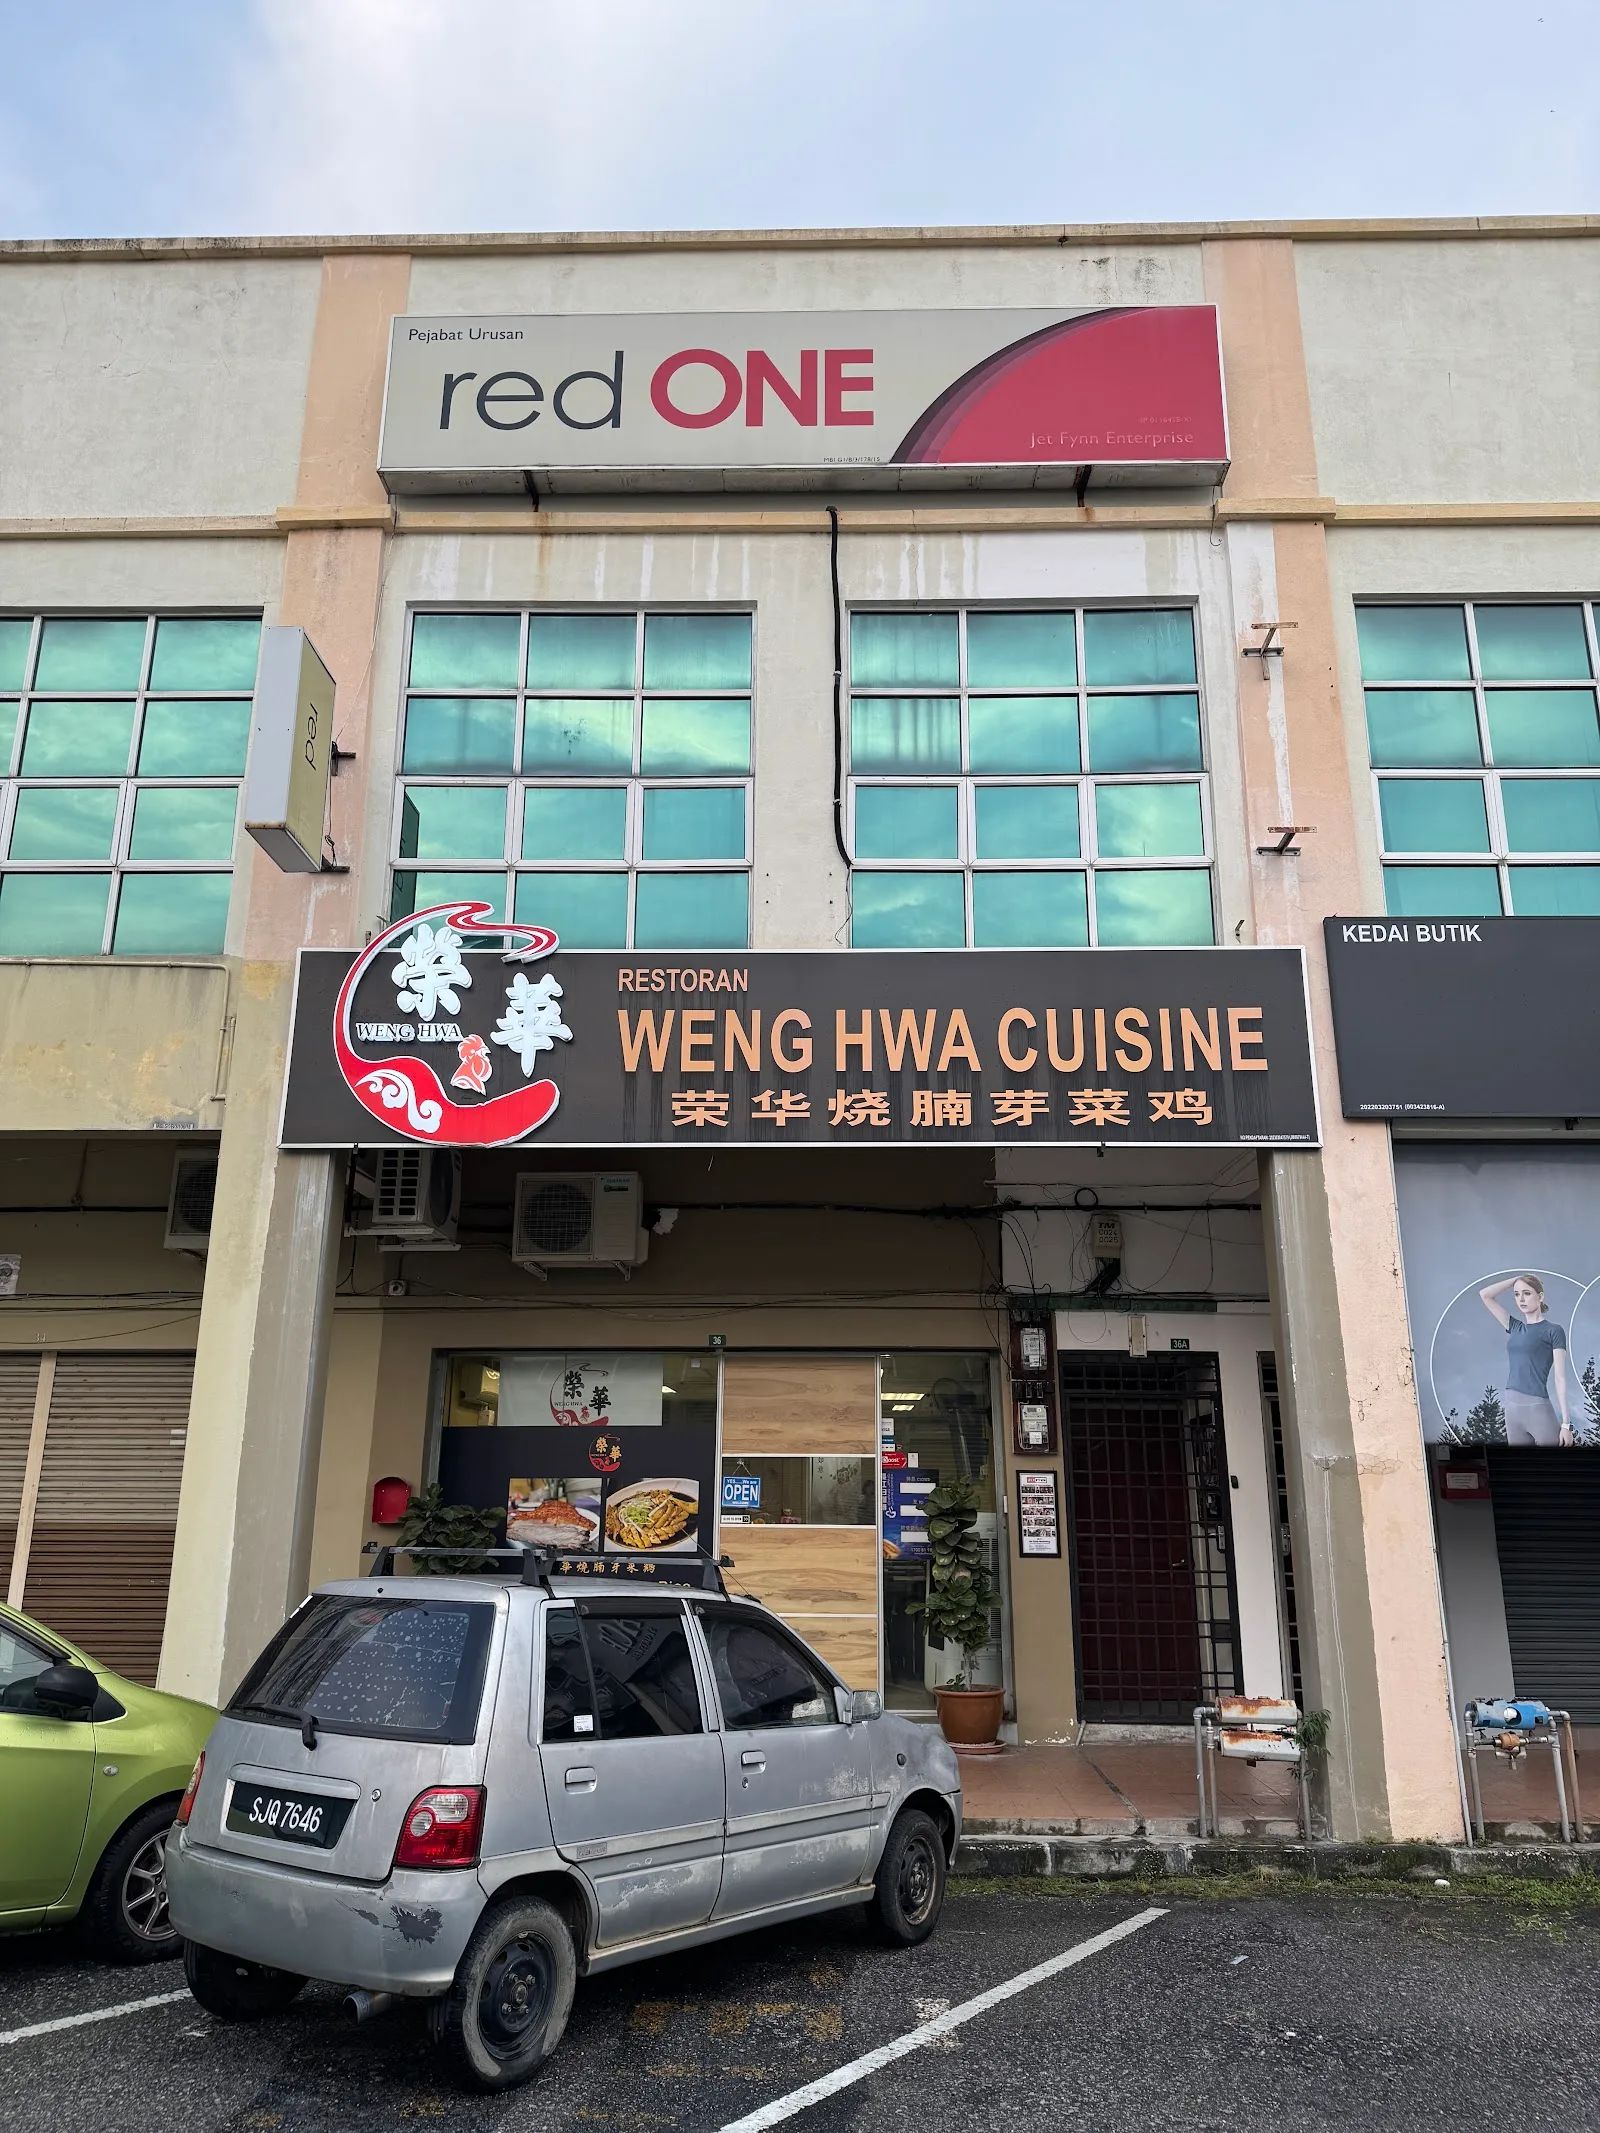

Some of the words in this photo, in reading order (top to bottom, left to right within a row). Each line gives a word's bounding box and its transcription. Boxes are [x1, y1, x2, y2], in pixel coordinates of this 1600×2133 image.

[408, 328, 463, 344] Pejabat
[469, 327, 524, 341] Urusan
[439, 350, 624, 431] red
[650, 348, 874, 430] ONE
[1030, 432, 1053, 449] Jet
[1060, 432, 1099, 448] Fynn
[1106, 431, 1194, 448] Enterprise
[305, 702, 318, 771] red
[1342, 924, 1409, 942] KEDAI
[1416, 924, 1482, 942] BUTIK
[618, 969, 748, 992] RESTORAN
[356, 1022, 413, 1039] WENG
[419, 1022, 461, 1039] HWA
[617, 1008, 813, 1073] WENG
[835, 1009, 982, 1073] HWA
[998, 1007, 1269, 1073] CUISINE
[671, 1087, 1213, 1127] 荣华烧腩芽菜鸡
[712, 1336, 722, 1345] 36
[1173, 1340, 1188, 1348] 36A
[724, 1484, 758, 1501] OPEN
[248, 1796, 281, 1827] SJQ
[282, 1801, 324, 1833] 7646
